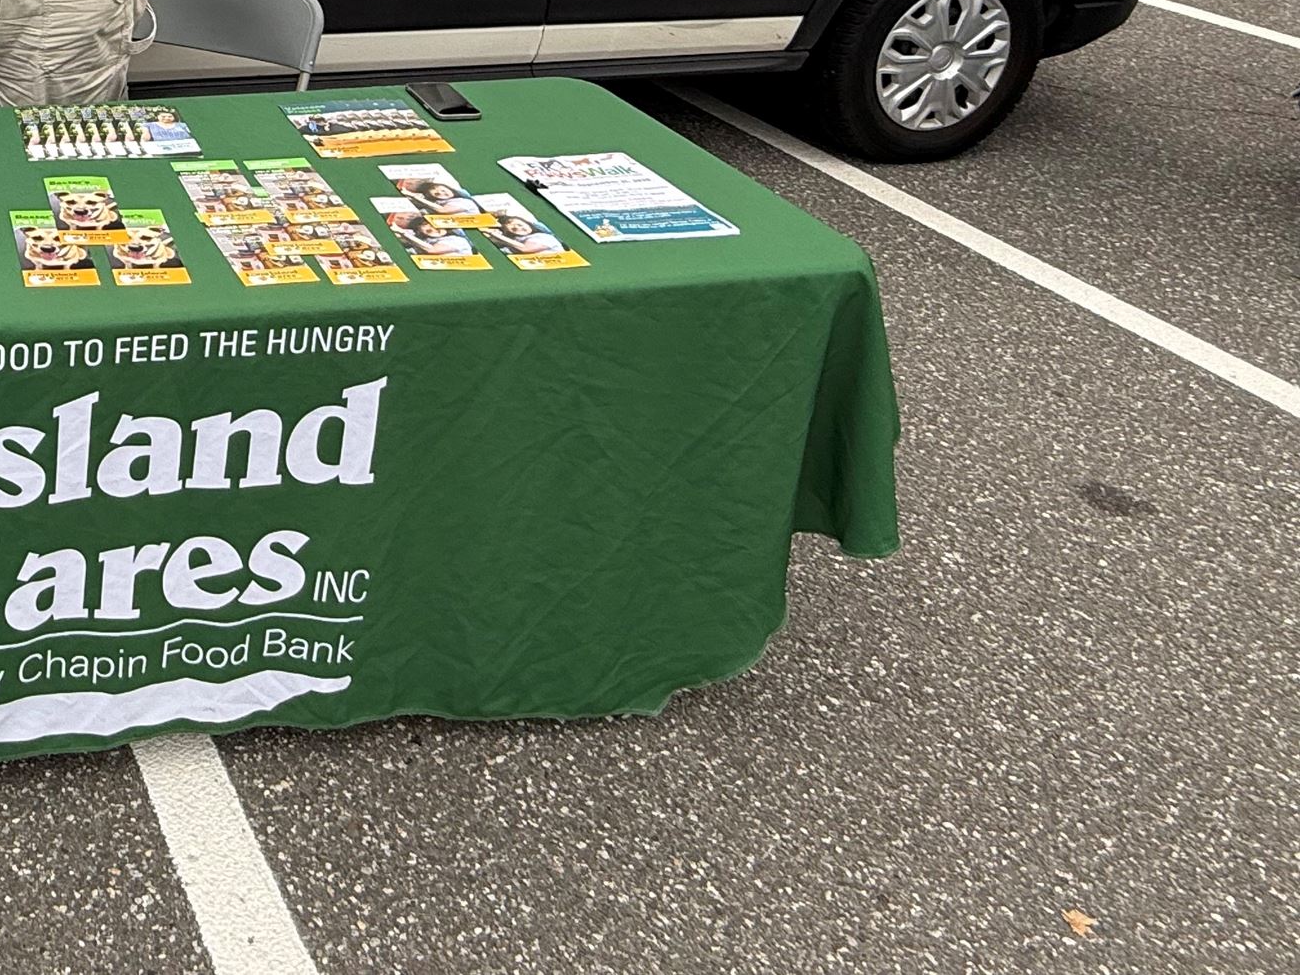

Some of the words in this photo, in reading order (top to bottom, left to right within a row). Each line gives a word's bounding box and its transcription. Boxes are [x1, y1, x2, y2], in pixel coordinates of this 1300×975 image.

[64, 338, 103, 367] TO
[114, 333, 189, 364] FEED
[199, 329, 258, 358] THE
[267, 324, 395, 355] HUNGRY
[312, 569, 371, 603] INC
[18, 649, 148, 686] Chapin
[161, 635, 250, 670] Food
[261, 628, 355, 665] Bank
